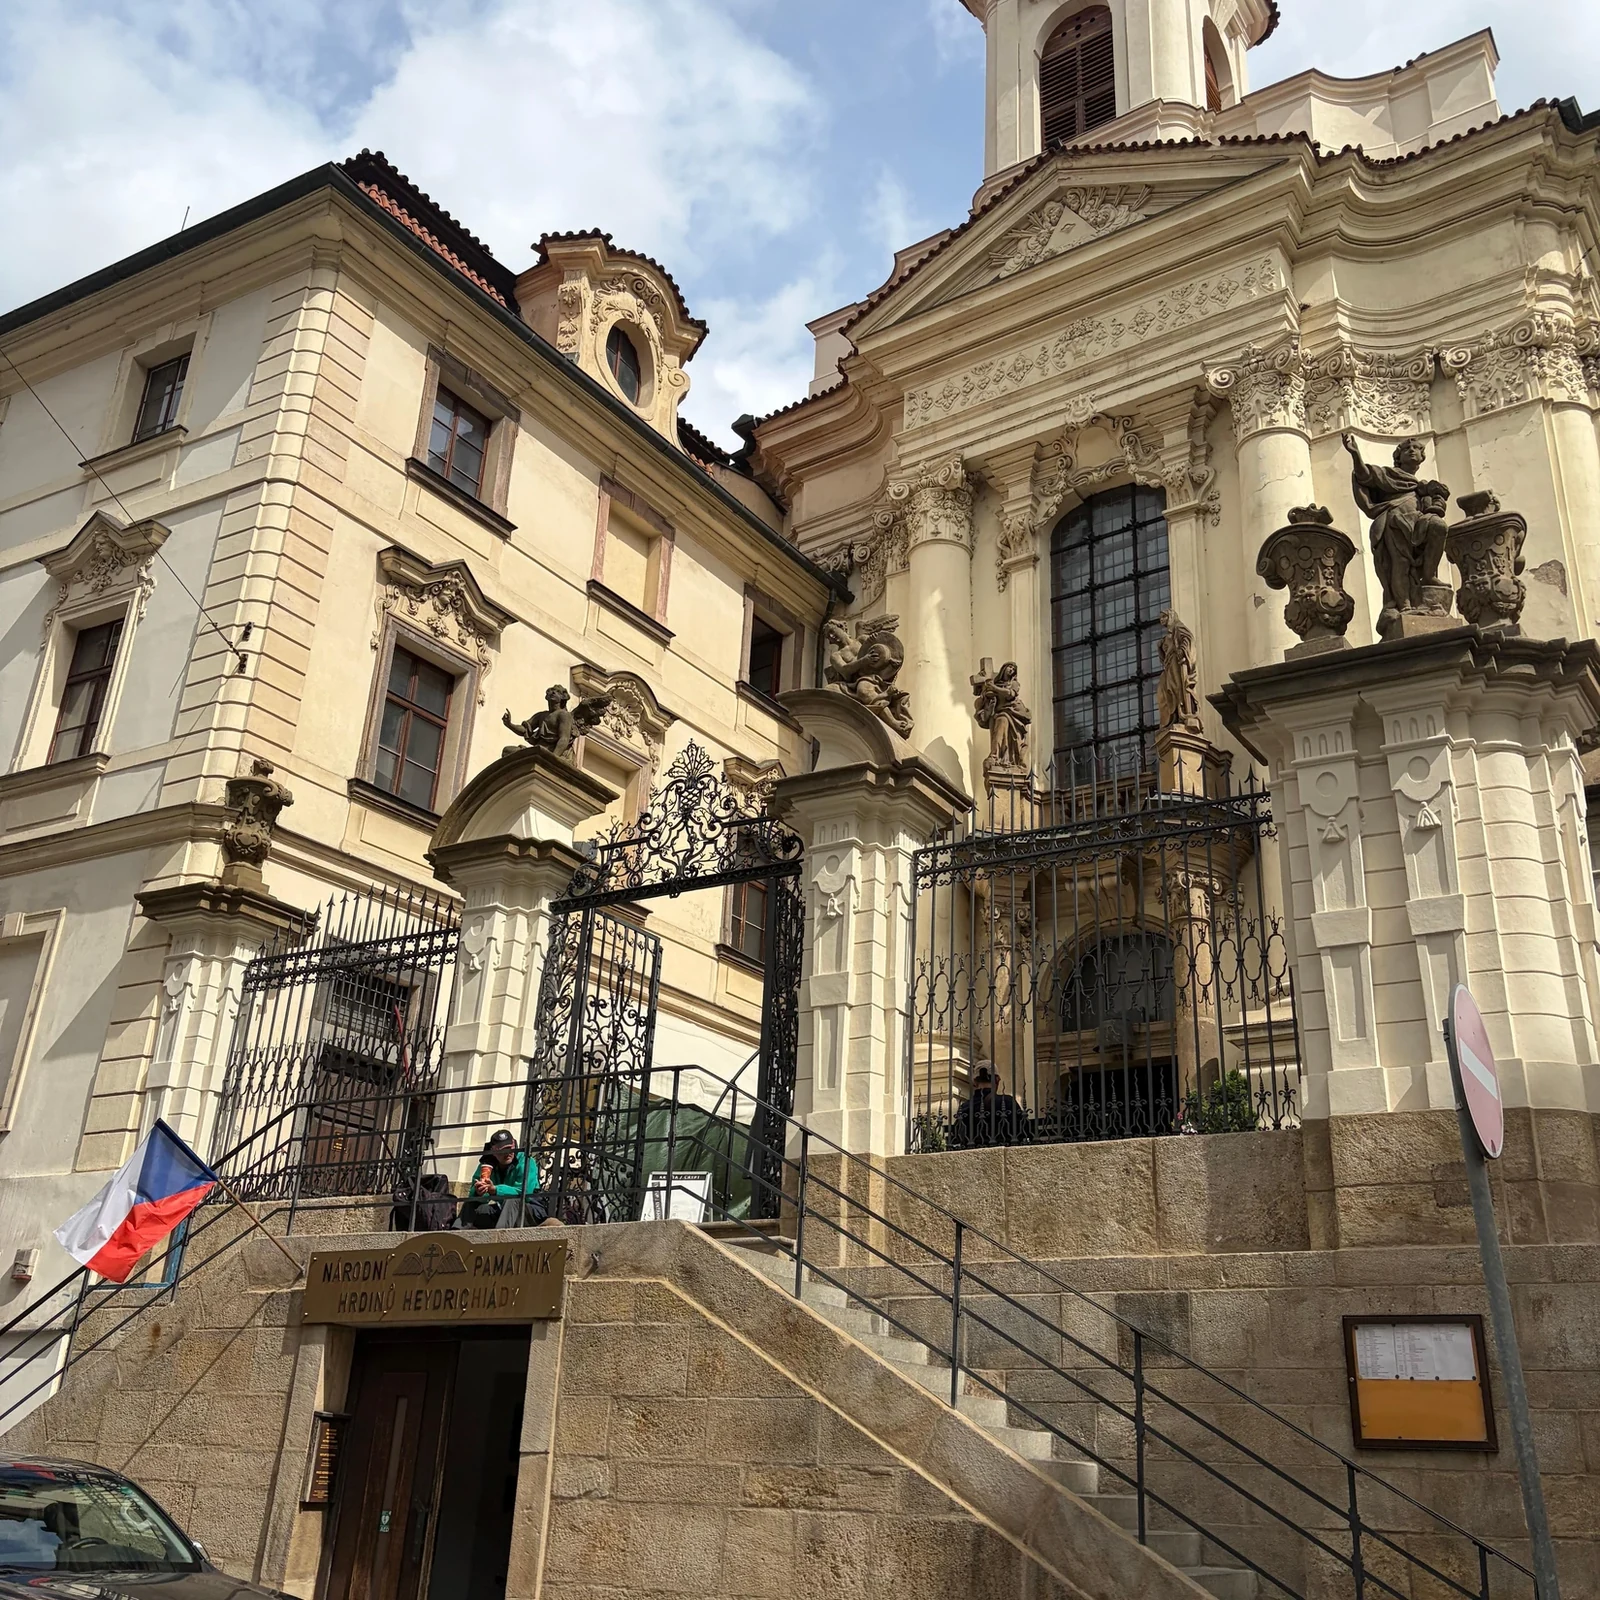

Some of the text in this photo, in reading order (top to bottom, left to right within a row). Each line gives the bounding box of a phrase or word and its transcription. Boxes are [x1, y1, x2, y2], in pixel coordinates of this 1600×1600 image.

[322, 1246, 552, 1282] NÁRODNÍ PAMÁTNÍK
[337, 1281, 520, 1313] HRDINŮ HEYDRICHIÁDY
